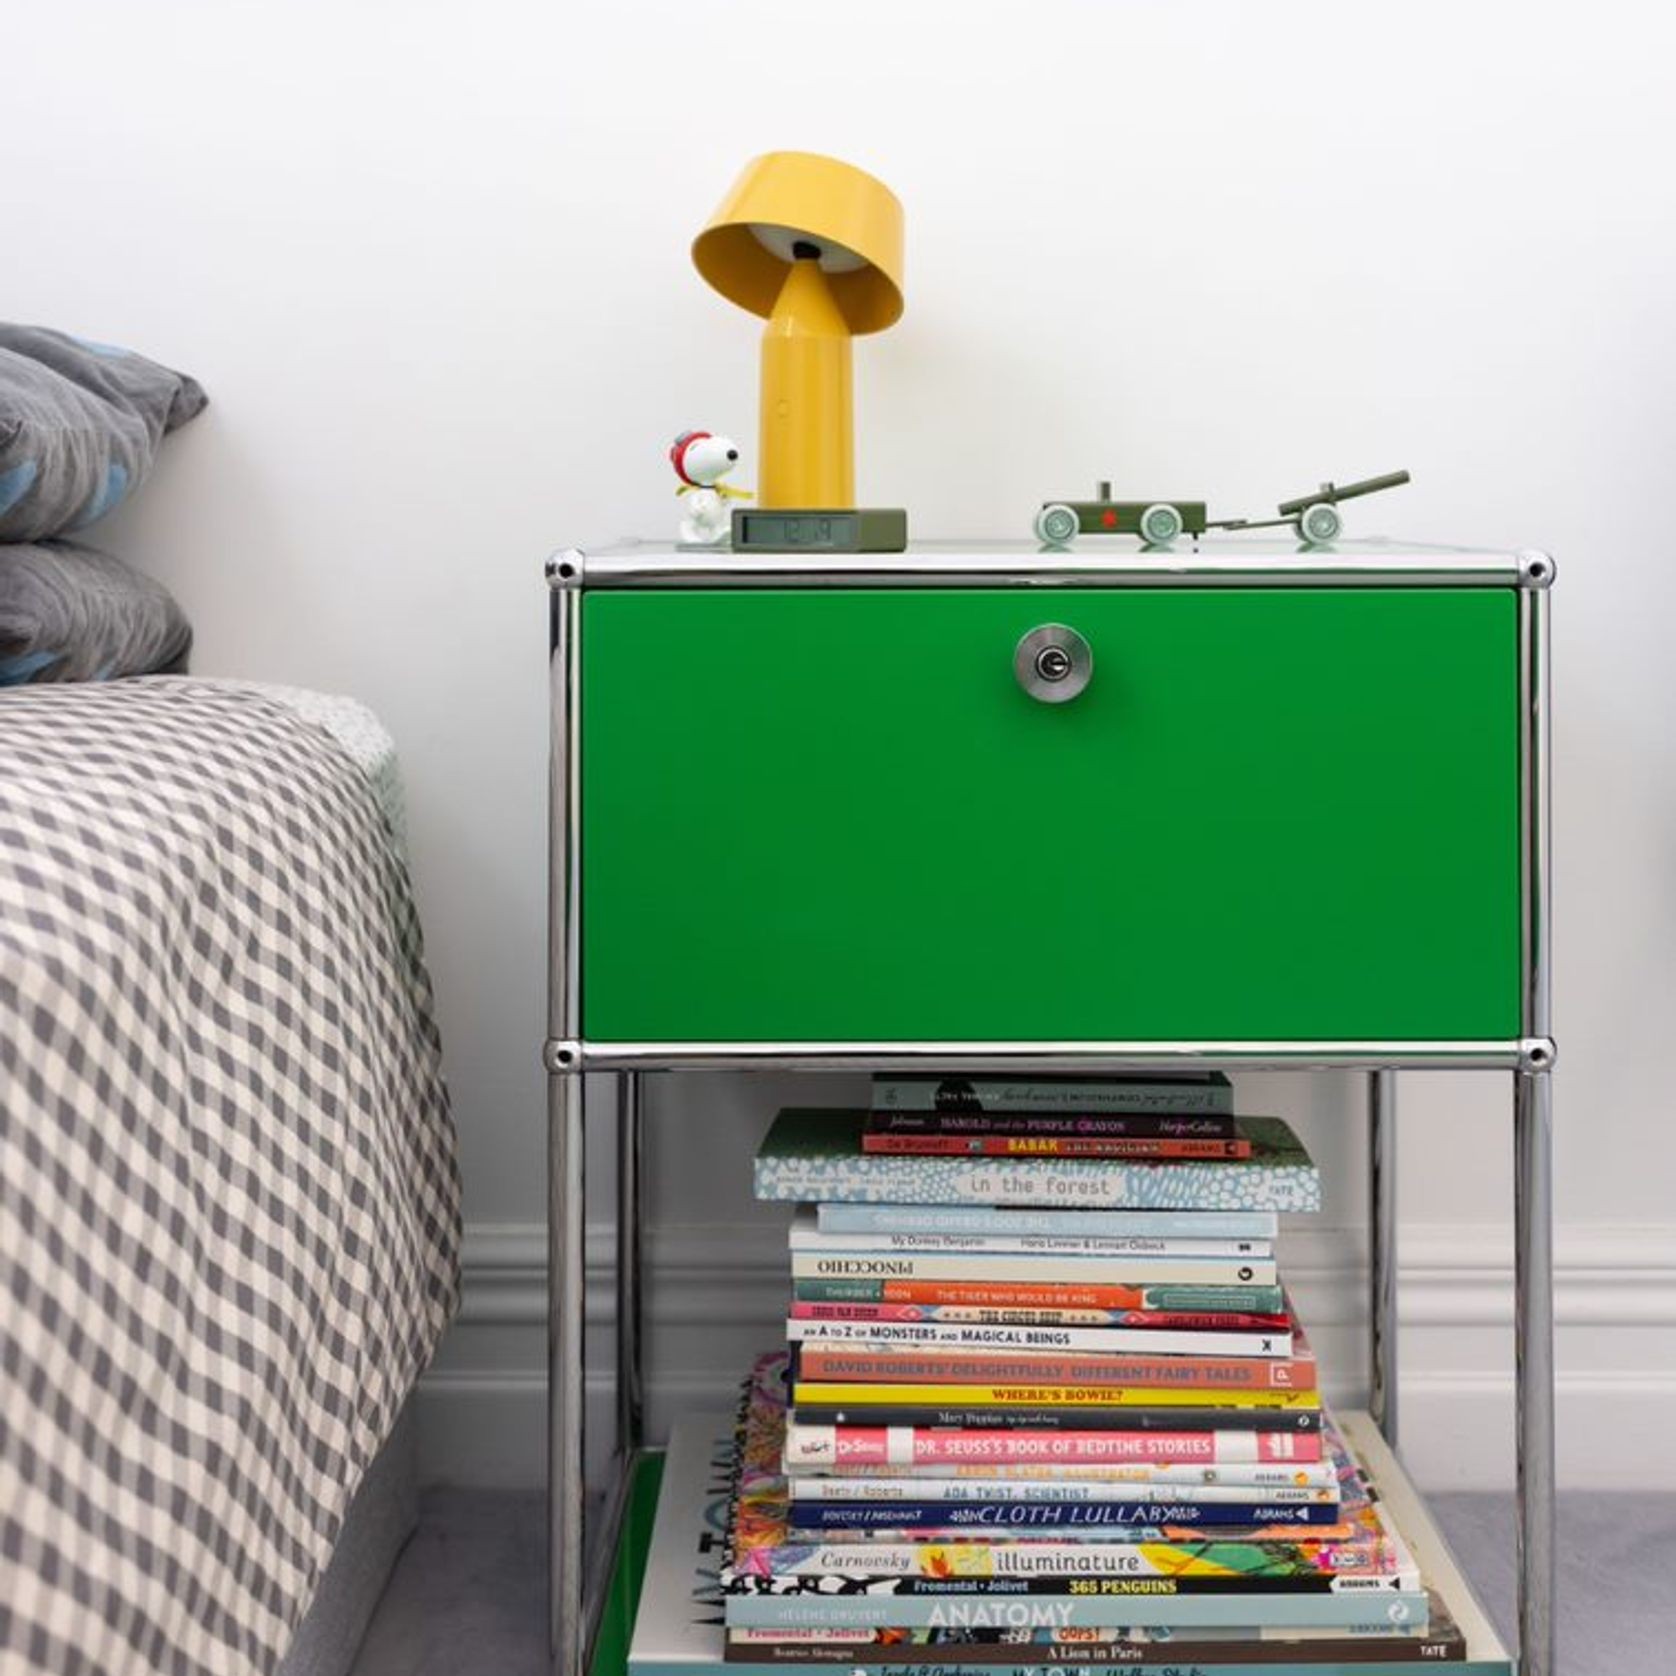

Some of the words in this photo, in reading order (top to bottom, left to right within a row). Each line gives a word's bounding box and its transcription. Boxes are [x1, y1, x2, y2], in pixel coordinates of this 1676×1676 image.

[941, 1118, 990, 1130] HAROLD
[1027, 1120, 1074, 1131] PURPLE
[1008, 1138, 1058, 1151] BABAR
[971, 1177, 991, 1193] in
[1002, 1177, 1034, 1193] the
[1046, 1177, 1110, 1195] forest
[817, 1259, 913, 1275] PINOCCHIO
[937, 1290, 958, 1301] THE
[819, 1326, 828, 1337] A
[831, 1330, 842, 1338] TO
[845, 1326, 852, 1337] Z
[870, 1328, 937, 1341] MONSTERS
[941, 1333, 957, 1342] AND
[961, 1331, 1022, 1344] MAGICAL
[1025, 1333, 1071, 1346] BEINGS
[824, 1361, 872, 1373] DAVID
[1206, 1368, 1251, 1381] TALES
[992, 1388, 1061, 1401] WHERE'S
[1064, 1389, 1124, 1402] BOWIE?
[916, 1438, 942, 1456] DR.
[945, 1438, 1002, 1456] SEUSS'S
[1007, 1439, 1050, 1456] BOOK
[1052, 1440, 1071, 1455] OF
[1078, 1440, 1144, 1455] BEDTIME
[1147, 1439, 1211, 1455] STORIES
[1024, 1487, 1090, 1500] SCIENTIST
[978, 1505, 1062, 1524] CLOTH
[1070, 1505, 1173, 1523] LULLABY
[1252, 1508, 1296, 1521] ABRAMS
[820, 1549, 912, 1570] Carnovsky
[996, 1551, 1140, 1572] illuminature
[913, 1580, 978, 1592] Fromental
[987, 1580, 1029, 1592] Jolivet
[1068, 1579, 1098, 1594] 365
[1101, 1579, 1177, 1594] PENGUINS
[927, 1602, 1075, 1628] ANATOMY
[1047, 1647, 1057, 1659] A
[1060, 1647, 1090, 1659] Lion
[1094, 1647, 1107, 1659] in
[1111, 1646, 1143, 1659] Paris
[1420, 1645, 1447, 1658] TATE
